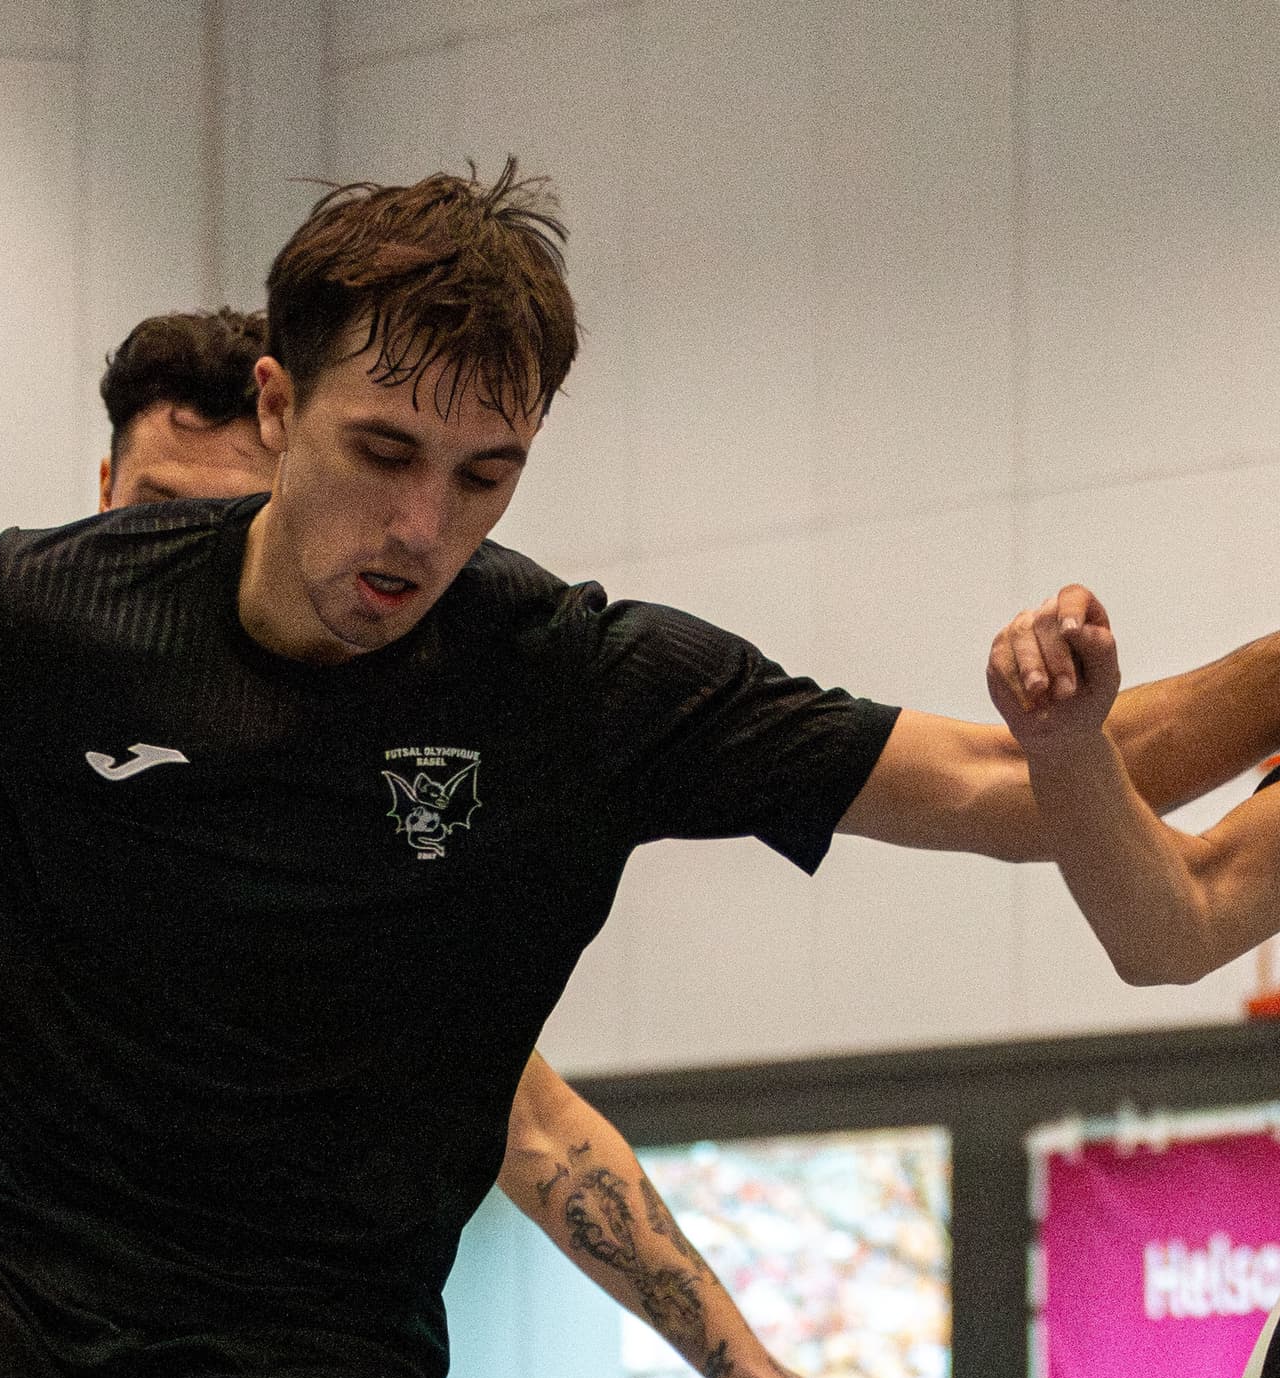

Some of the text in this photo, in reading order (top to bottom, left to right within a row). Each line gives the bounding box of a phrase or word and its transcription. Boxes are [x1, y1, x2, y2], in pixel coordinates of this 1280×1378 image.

[385, 747, 480, 761] FUTSAL OLYMPIQUE
[416, 757, 447, 767] BASEL
